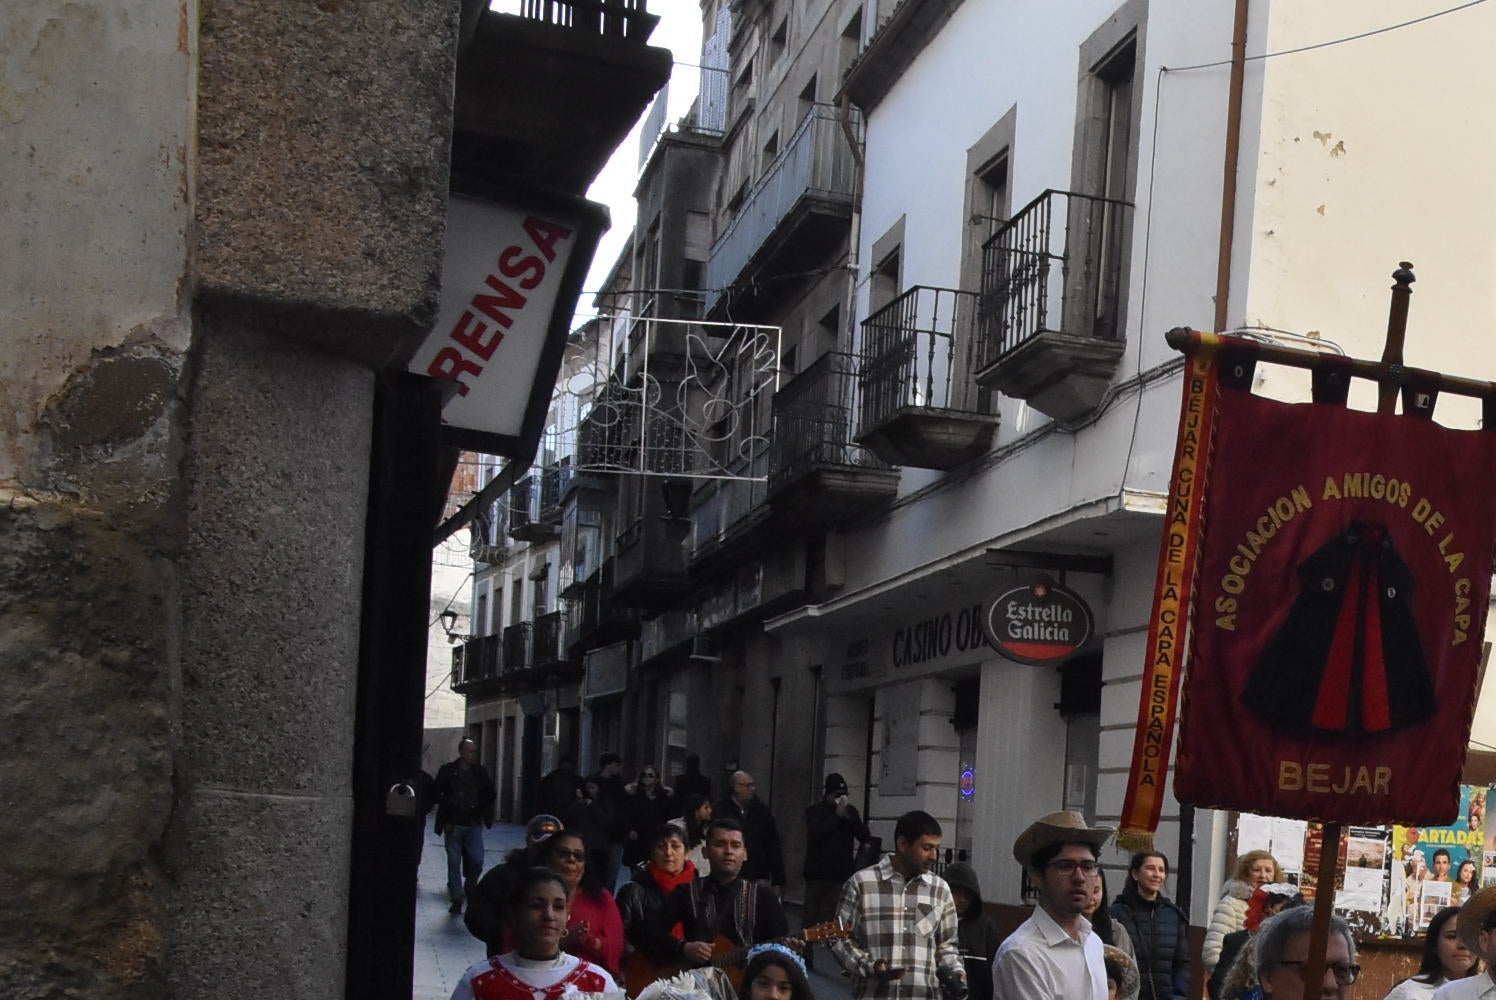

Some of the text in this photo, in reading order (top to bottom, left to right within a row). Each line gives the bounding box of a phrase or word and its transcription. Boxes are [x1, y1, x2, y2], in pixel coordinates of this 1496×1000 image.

[428, 215, 572, 424] RENSA
[1171, 468, 1193, 527] CUNA
[1168, 533, 1185, 564] DE
[1214, 472, 1473, 647] ASOCIACION AMIGOS DE LA CAPA
[1162, 572, 1178, 601] LA
[1005, 600, 1073, 622] Estrella
[1007, 619, 1070, 641] Galicia
[892, 612, 953, 668] CASINO
[1155, 609, 1176, 667] CAPA
[1278, 760, 1392, 795] BEJAR
